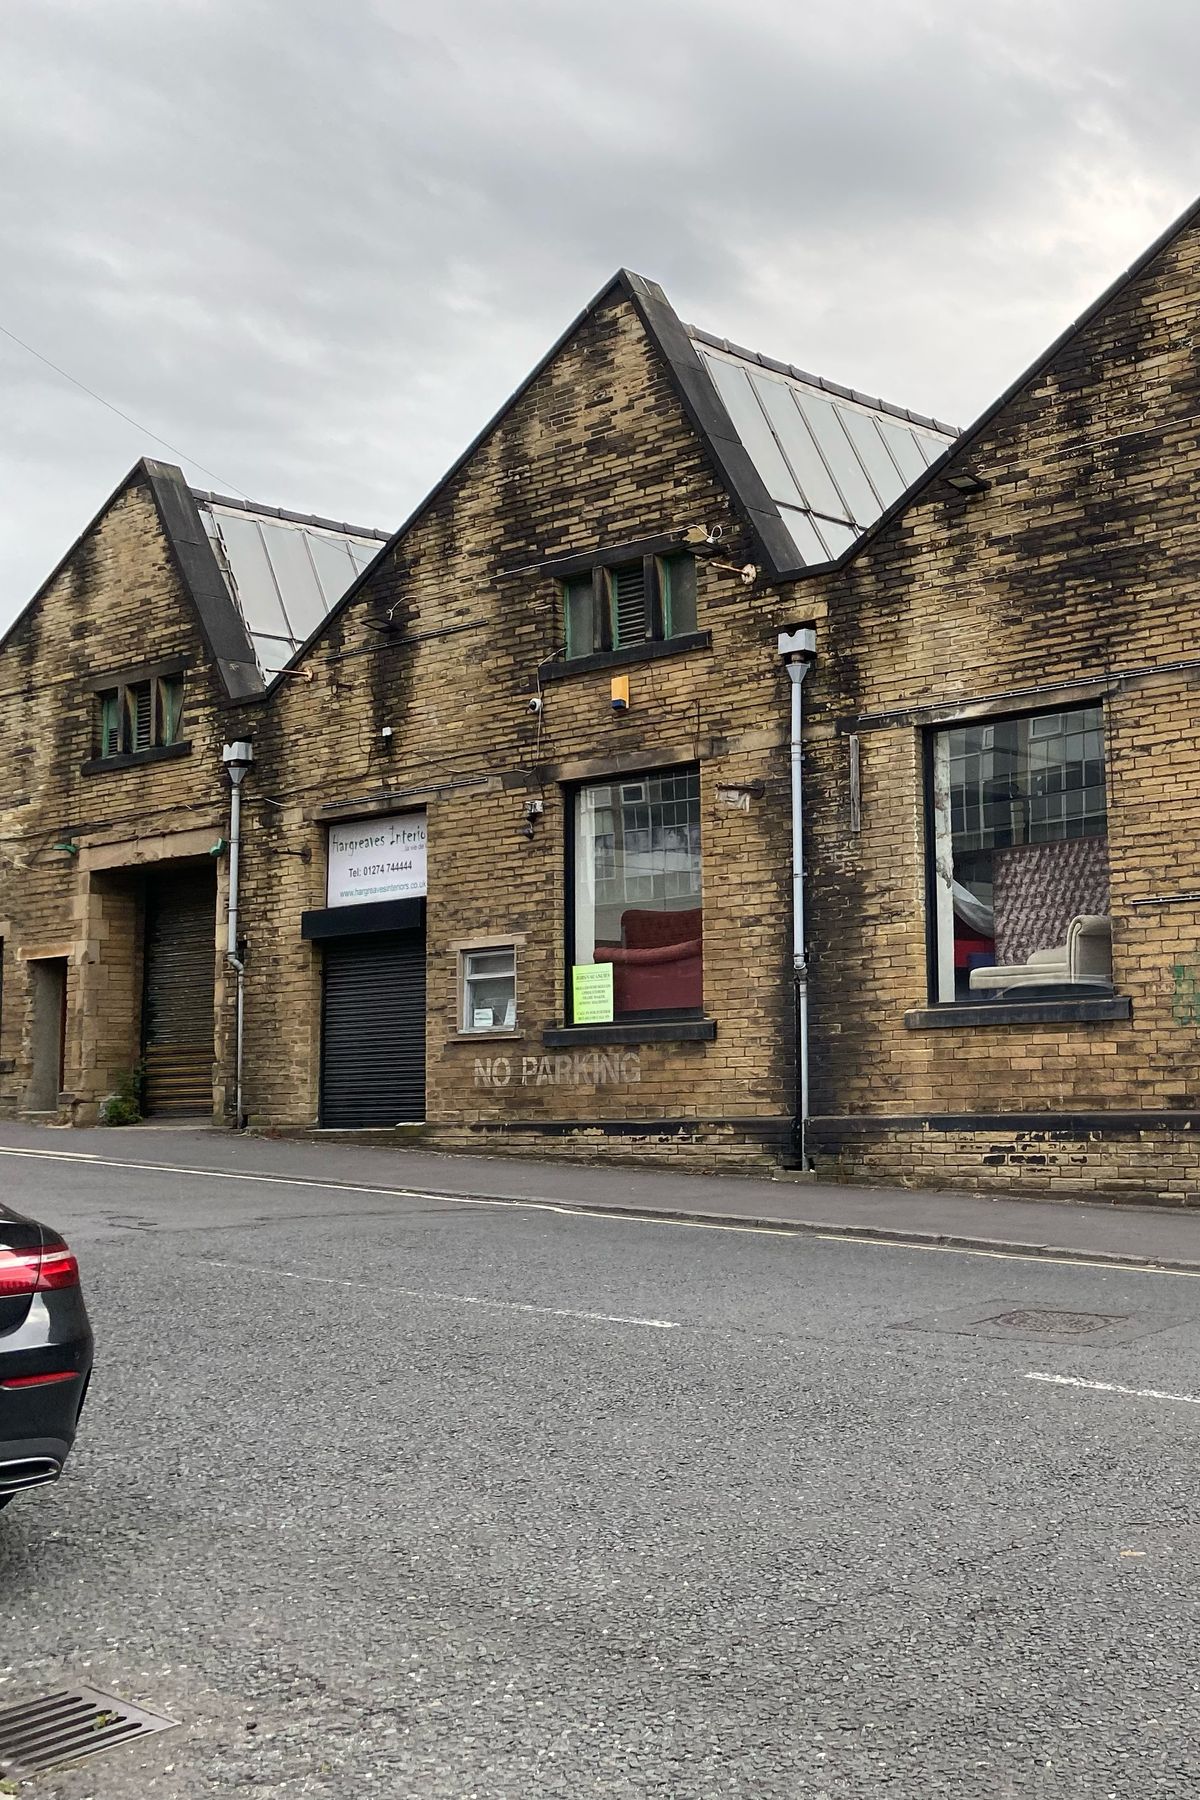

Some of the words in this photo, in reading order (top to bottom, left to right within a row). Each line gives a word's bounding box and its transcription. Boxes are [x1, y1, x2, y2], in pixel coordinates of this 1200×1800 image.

[332, 834, 385, 857] Hargreaves
[389, 825, 426, 846] Interio
[348, 868, 362, 878] Tel:
[363, 864, 385, 876] 01274
[386, 860, 413, 873] 744444
[473, 1057, 511, 1087] NO
[521, 1052, 641, 1086] PARKING
